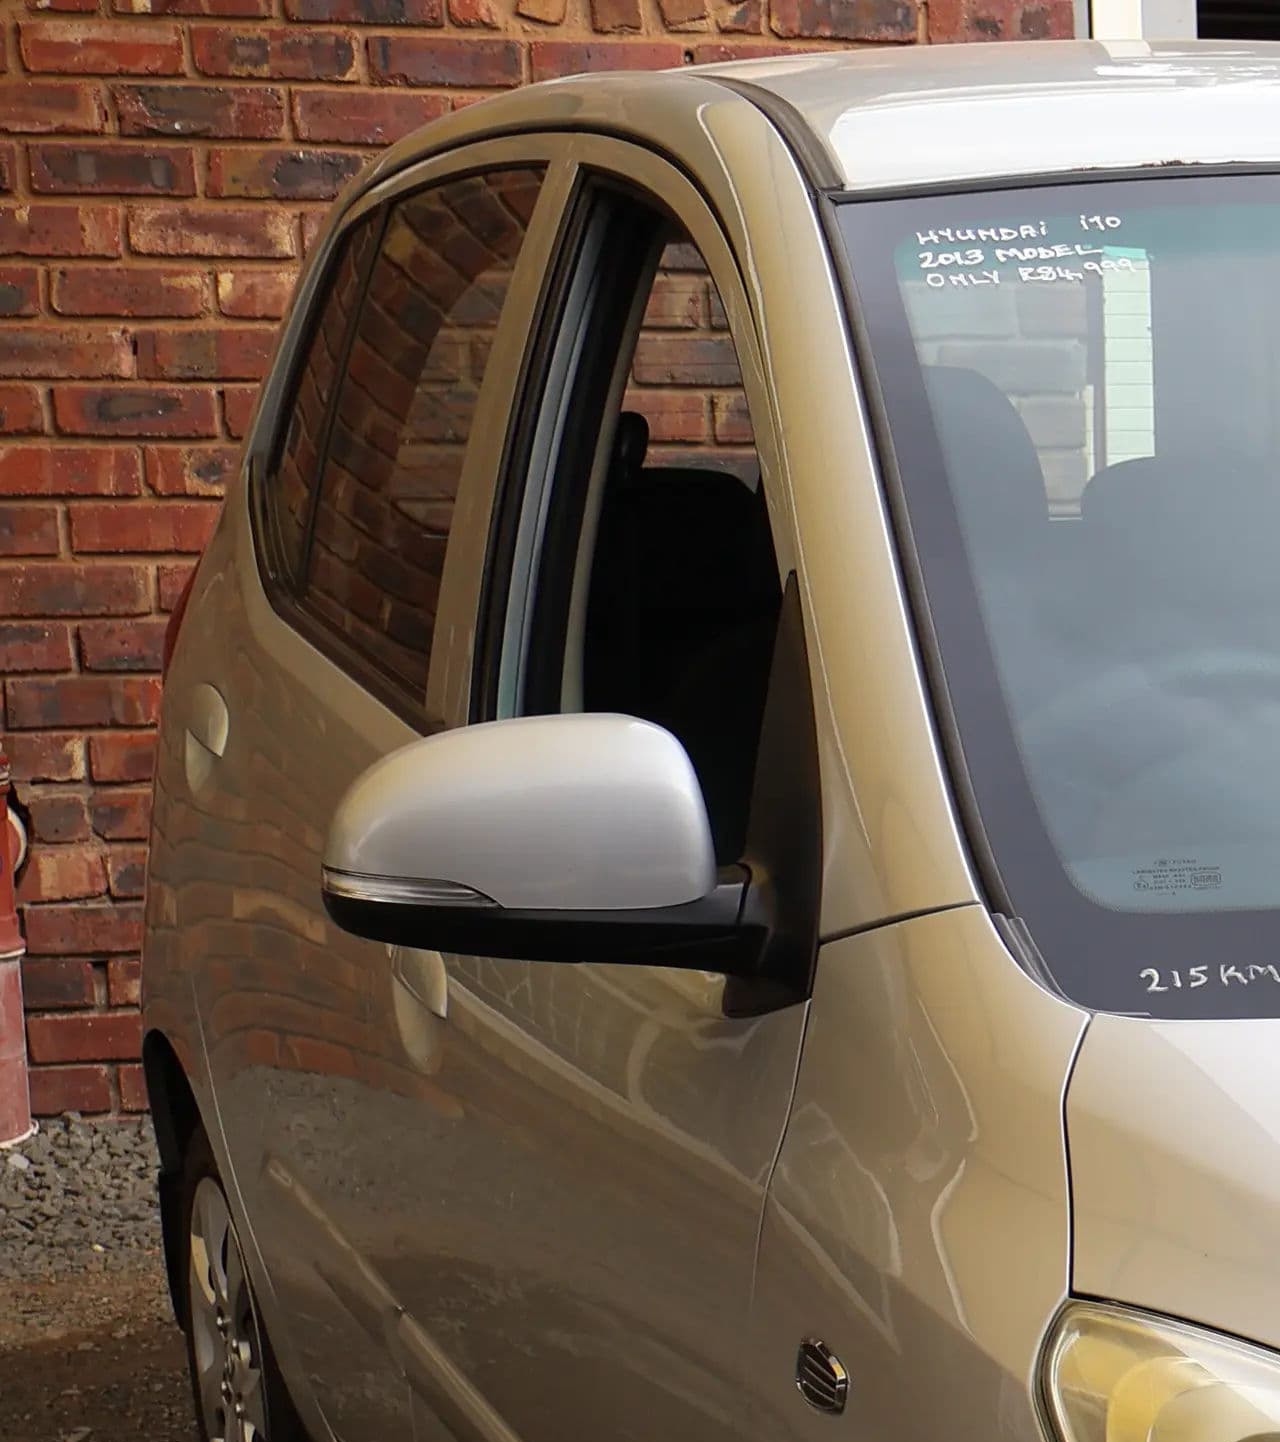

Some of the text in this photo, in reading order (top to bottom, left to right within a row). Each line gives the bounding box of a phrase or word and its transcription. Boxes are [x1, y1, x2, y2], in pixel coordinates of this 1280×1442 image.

[918, 244, 1104, 268] 2013 MODEL
[926, 270, 1001, 287] ONLY
